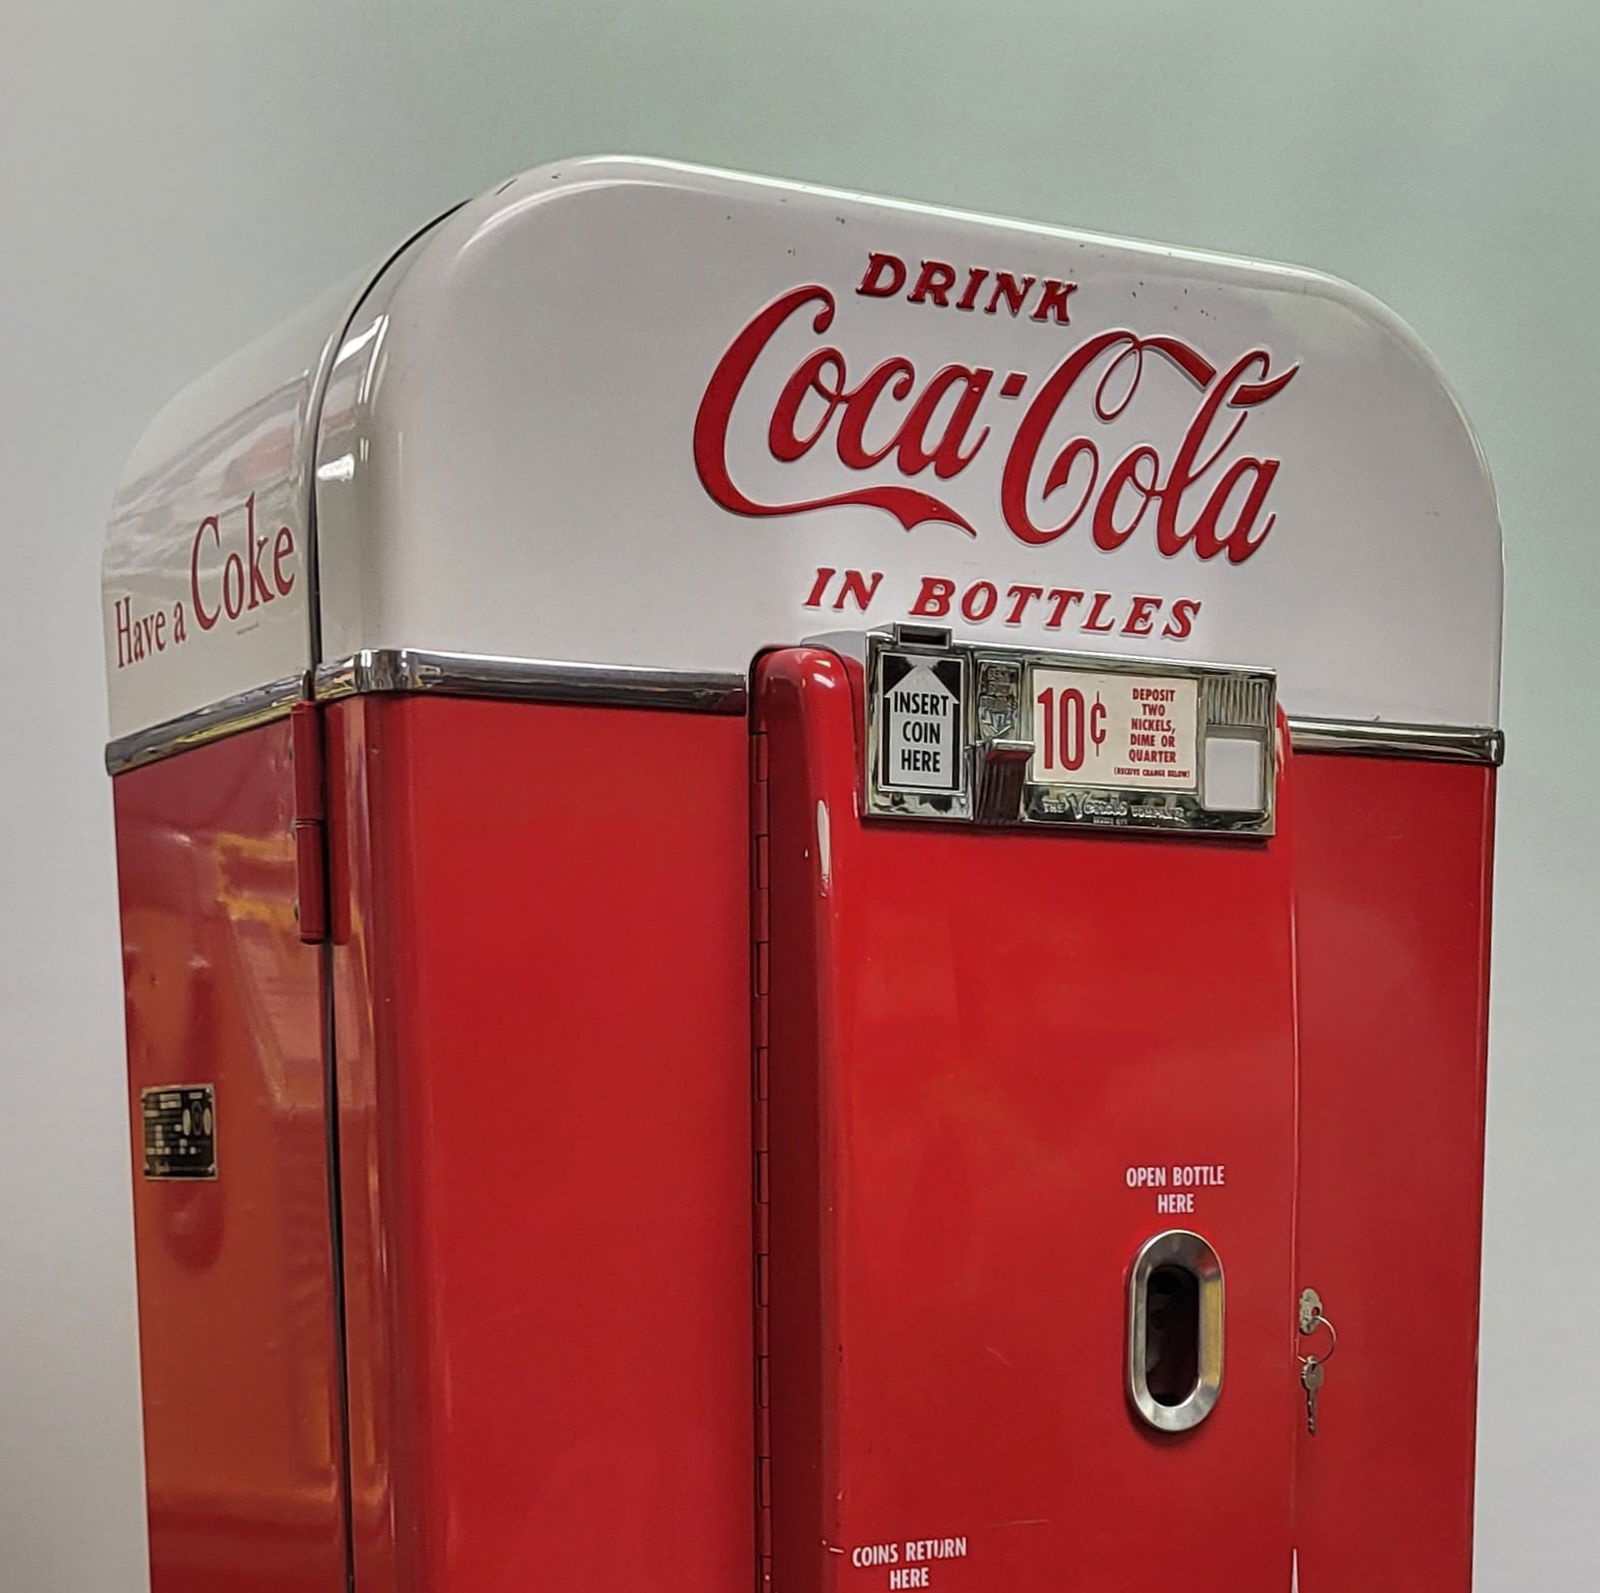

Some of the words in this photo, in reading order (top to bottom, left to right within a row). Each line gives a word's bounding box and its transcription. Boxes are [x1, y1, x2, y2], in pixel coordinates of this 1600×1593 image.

[856, 252, 1078, 324] DRINK
[693, 284, 1299, 564] Coca-Cola
[115, 596, 167, 668] Have
[174, 601, 186, 644] a
[191, 490, 296, 630] Coke
[804, 567, 883, 612] IN
[909, 576, 1202, 640] BOTTLES
[894, 691, 949, 716] INSERT
[1132, 688, 1176, 702] DEPOSIT
[1142, 704, 1165, 716] TWO
[902, 721, 941, 744] COIN
[1037, 687, 1107, 771] 10¢
[1131, 718, 1176, 734] NICKELS,
[1130, 734, 1156, 746] DIME
[1161, 735, 1176, 747] OR
[901, 749, 941, 772] HERE
[1128, 749, 1177, 763] QUARTER
[1126, 1167, 1166, 1187] OPEN
[1173, 1166, 1225, 1186] BOTTLE
[1157, 1193, 1194, 1213] HERE
[852, 1543, 899, 1567] COINS
[905, 1536, 967, 1562] RETURN
[889, 1567, 929, 1590] HERE
